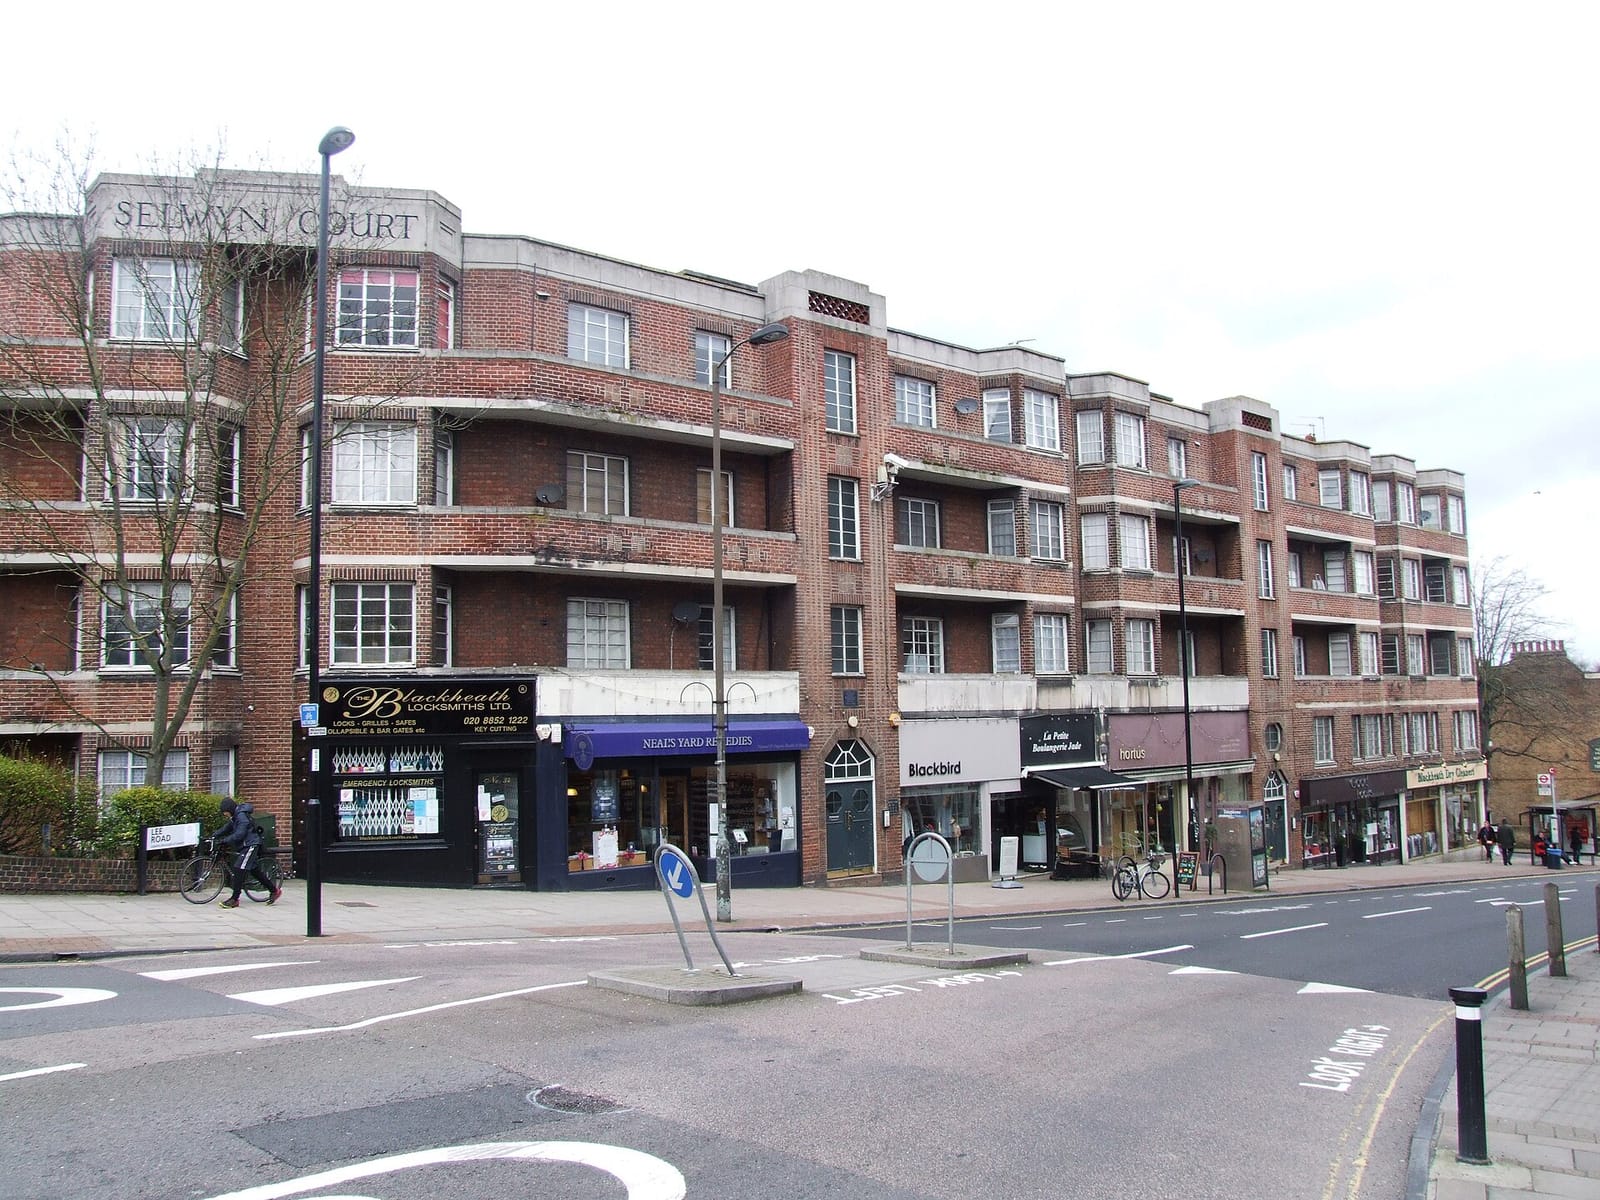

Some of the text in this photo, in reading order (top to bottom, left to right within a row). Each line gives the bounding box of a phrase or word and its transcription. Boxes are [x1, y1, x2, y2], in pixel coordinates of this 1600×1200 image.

[115, 200, 419, 240] SELWYN COURT
[343, 686, 511, 719] Blackheath
[407, 702, 514, 712] LOCKSMITHS LTD.
[463, 716, 529, 725] 020 8852 1222
[1043, 731, 1070, 740] La Petite
[643, 738, 676, 749] NEAL'S
[679, 737, 704, 748] YARD
[706, 735, 753, 747] REEDIES
[1032, 741, 1082, 753] Boulangerie Jade
[1119, 748, 1146, 760] hortus
[908, 761, 961, 777] Blackbird
[342, 779, 434, 788] EMERGENCY LOCKSMITHS
[151, 835, 171, 843] ROAD
[822, 972, 1002, 1004] LEFT LOOK
[1299, 1028, 1388, 1092] LOOK RIGHT
